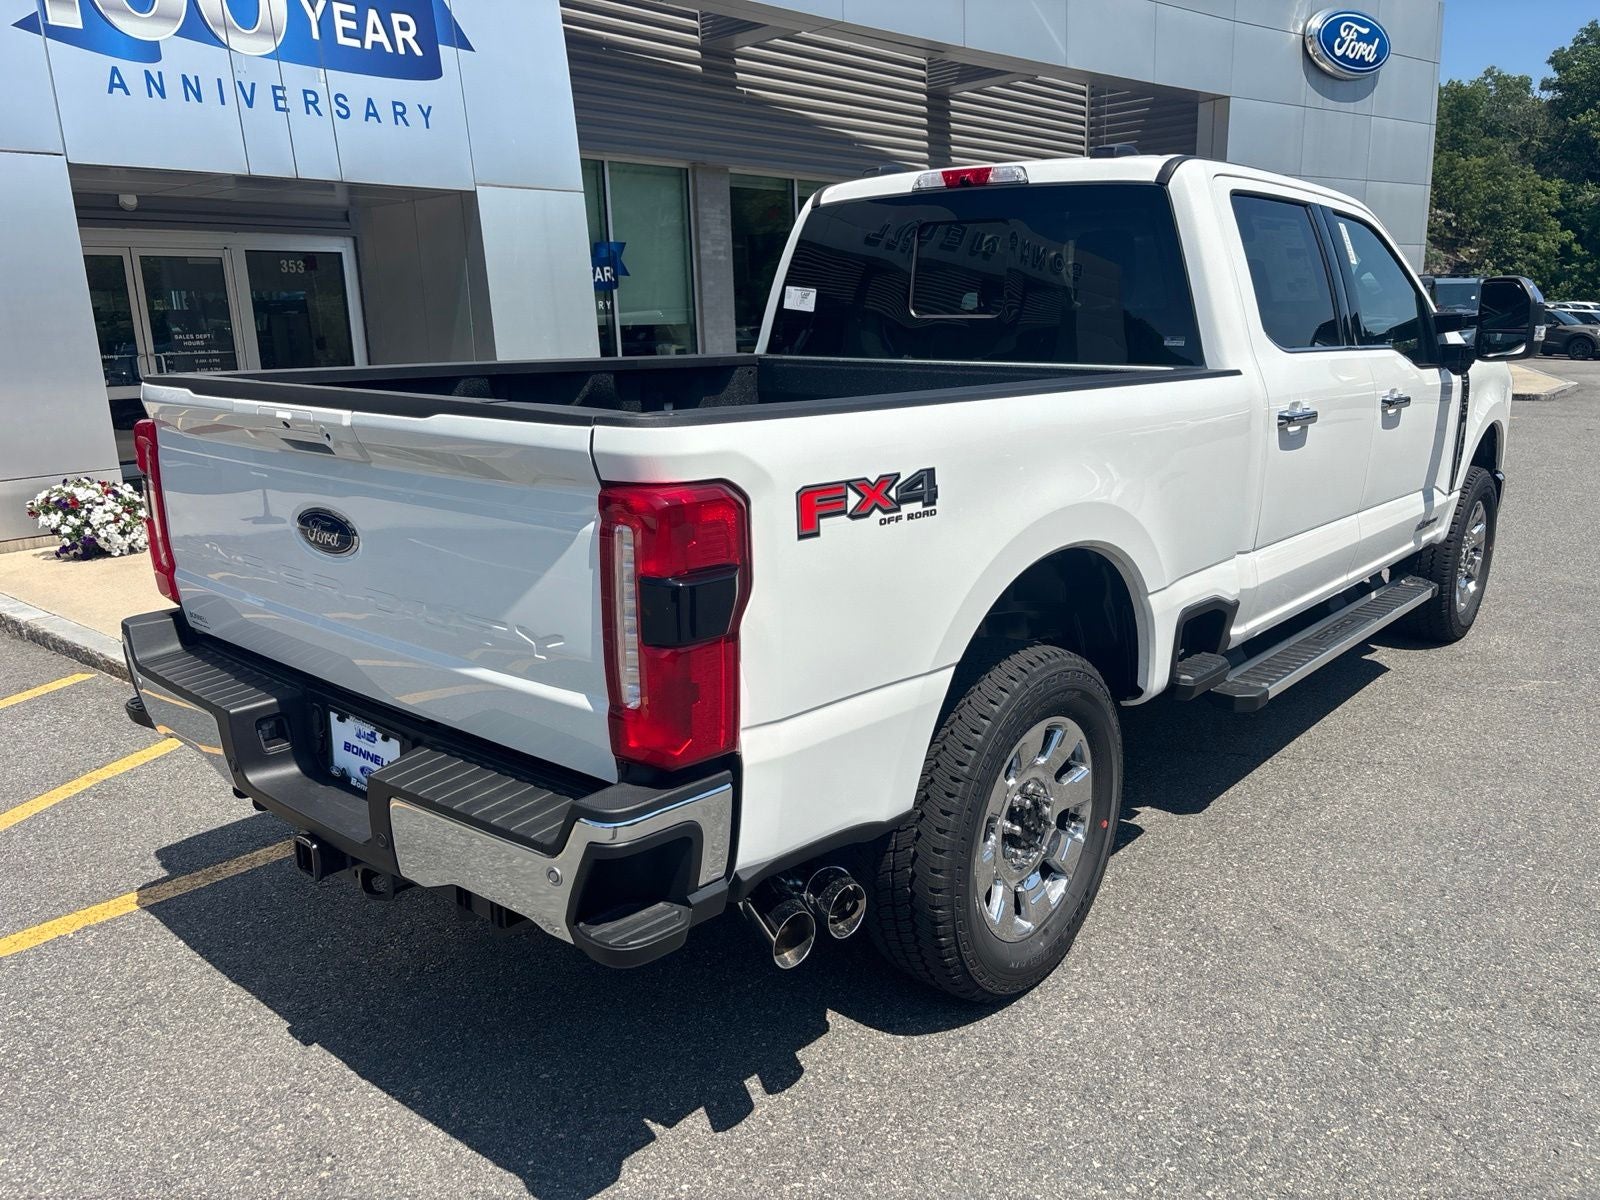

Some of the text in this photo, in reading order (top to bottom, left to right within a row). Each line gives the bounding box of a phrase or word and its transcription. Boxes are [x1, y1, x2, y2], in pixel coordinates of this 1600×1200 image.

[302, 0, 424, 56] YEAR
[107, 65, 433, 130] ANNIVERSARY
[280, 259, 305, 274] 353
[795, 467, 938, 541] FX4
[879, 508, 937, 526] OFF ROAD
[343, 740, 390, 767] BONNEL
